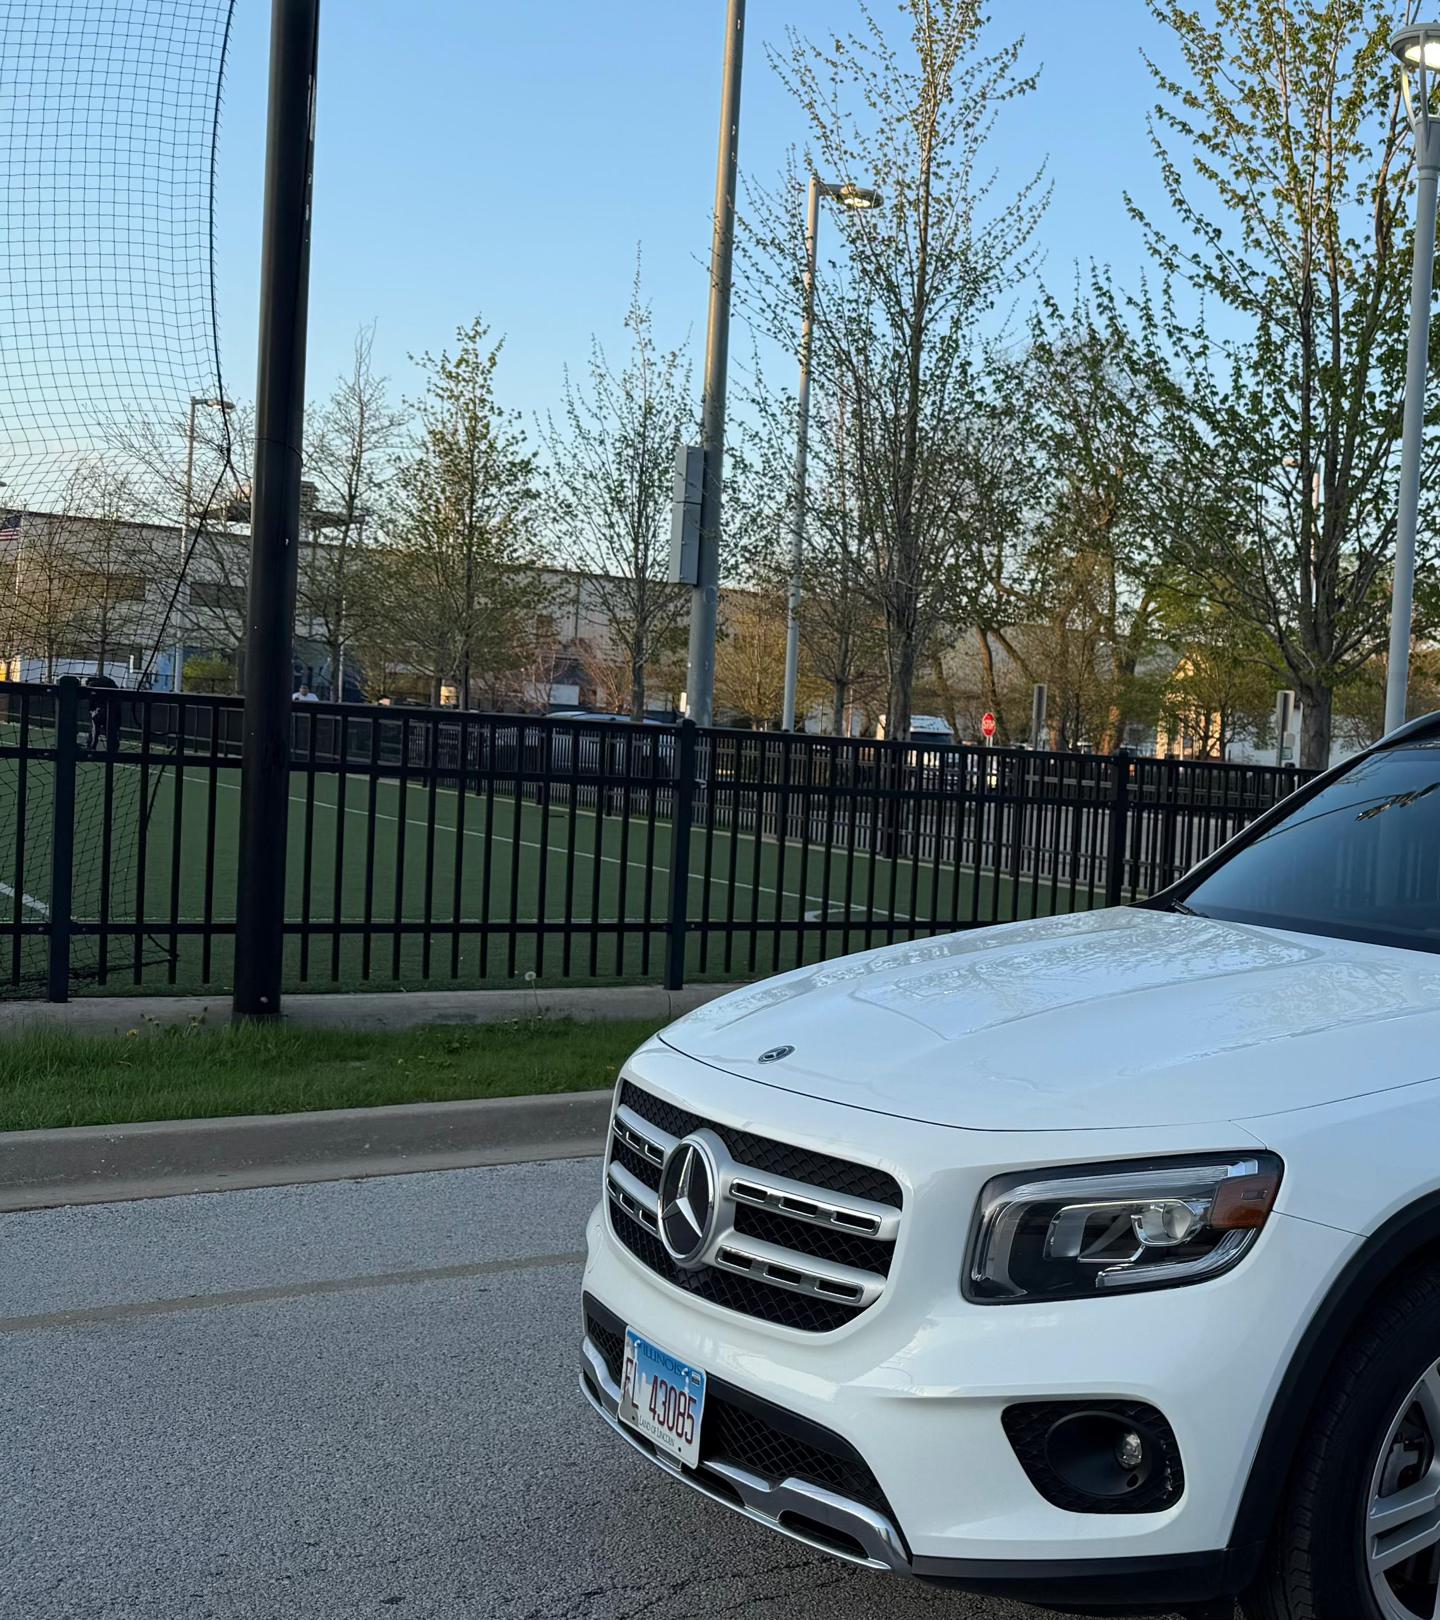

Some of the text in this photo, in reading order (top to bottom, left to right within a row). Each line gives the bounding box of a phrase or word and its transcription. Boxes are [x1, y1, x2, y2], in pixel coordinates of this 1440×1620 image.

[983, 720, 995, 729] STOP
[643, 1346, 683, 1376] ILLINOIS
[649, 1375, 697, 1445] 43085
